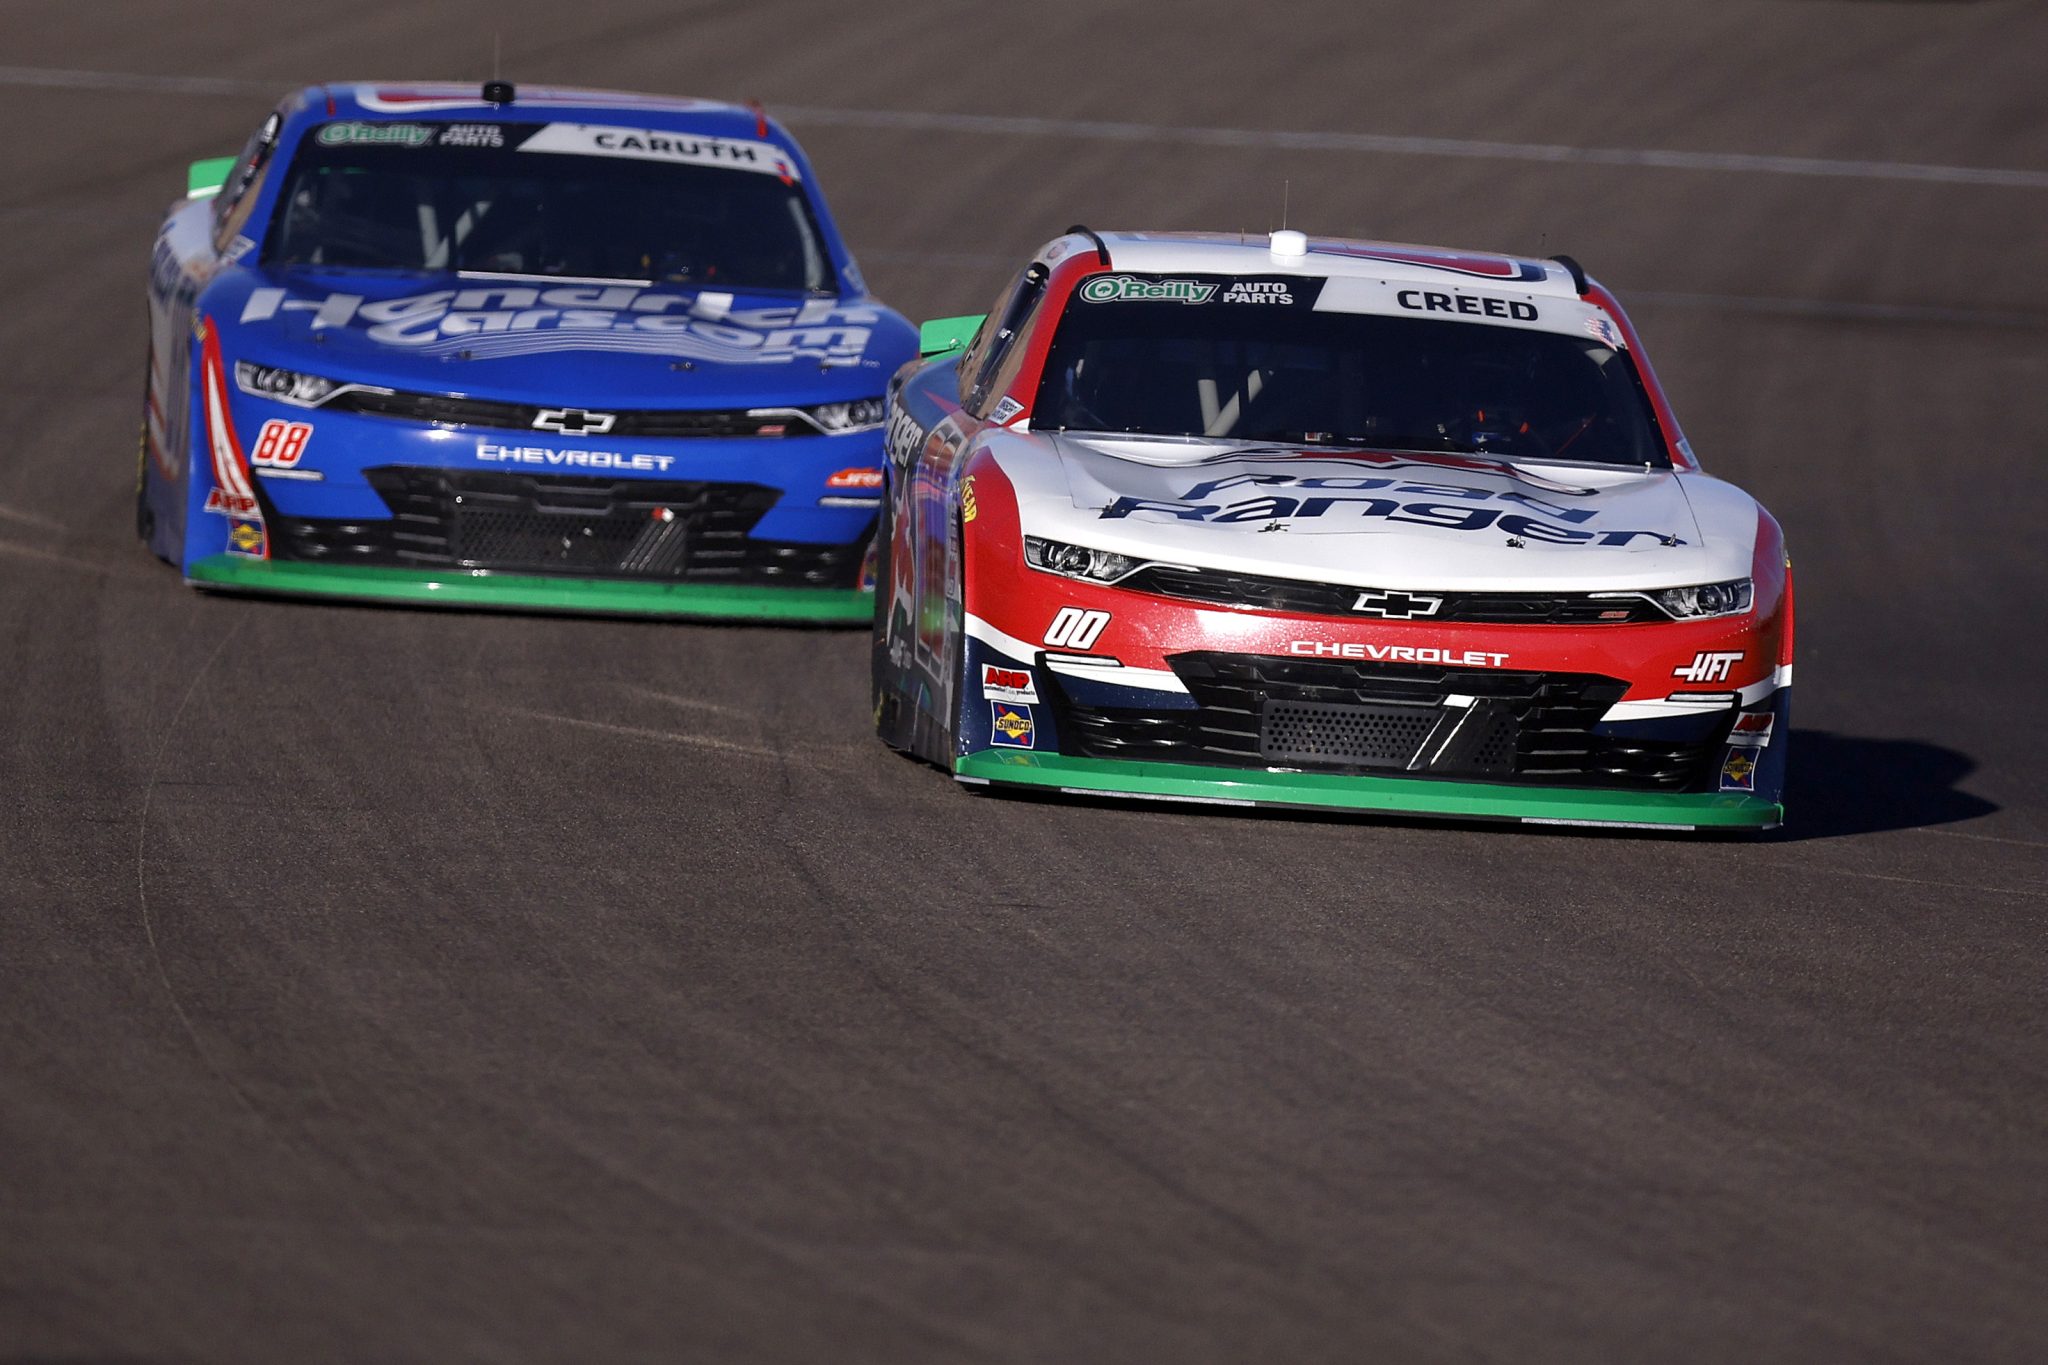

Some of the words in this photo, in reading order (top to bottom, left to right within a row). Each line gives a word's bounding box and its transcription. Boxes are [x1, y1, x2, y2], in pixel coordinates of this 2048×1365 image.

[440, 134, 503, 147] PARTS
[449, 125, 500, 135] AUTO
[594, 133, 758, 162] CARUTH
[1085, 277, 1215, 303] O'Reilly
[1223, 292, 1294, 305] PARTS
[1230, 282, 1288, 294] AUTO
[239, 287, 879, 330] Hendrick
[1397, 290, 1539, 321] CREED
[251, 418, 314, 469] 88
[476, 443, 676, 472] CHEVROLET
[1098, 496, 1688, 547] Ranger
[1043, 606, 1112, 650] 00
[1290, 640, 1510, 667] CHEVROLET
[1673, 652, 1744, 682] HFT
[984, 666, 1030, 690] ARP
[997, 718, 1030, 731] SUNOCO
